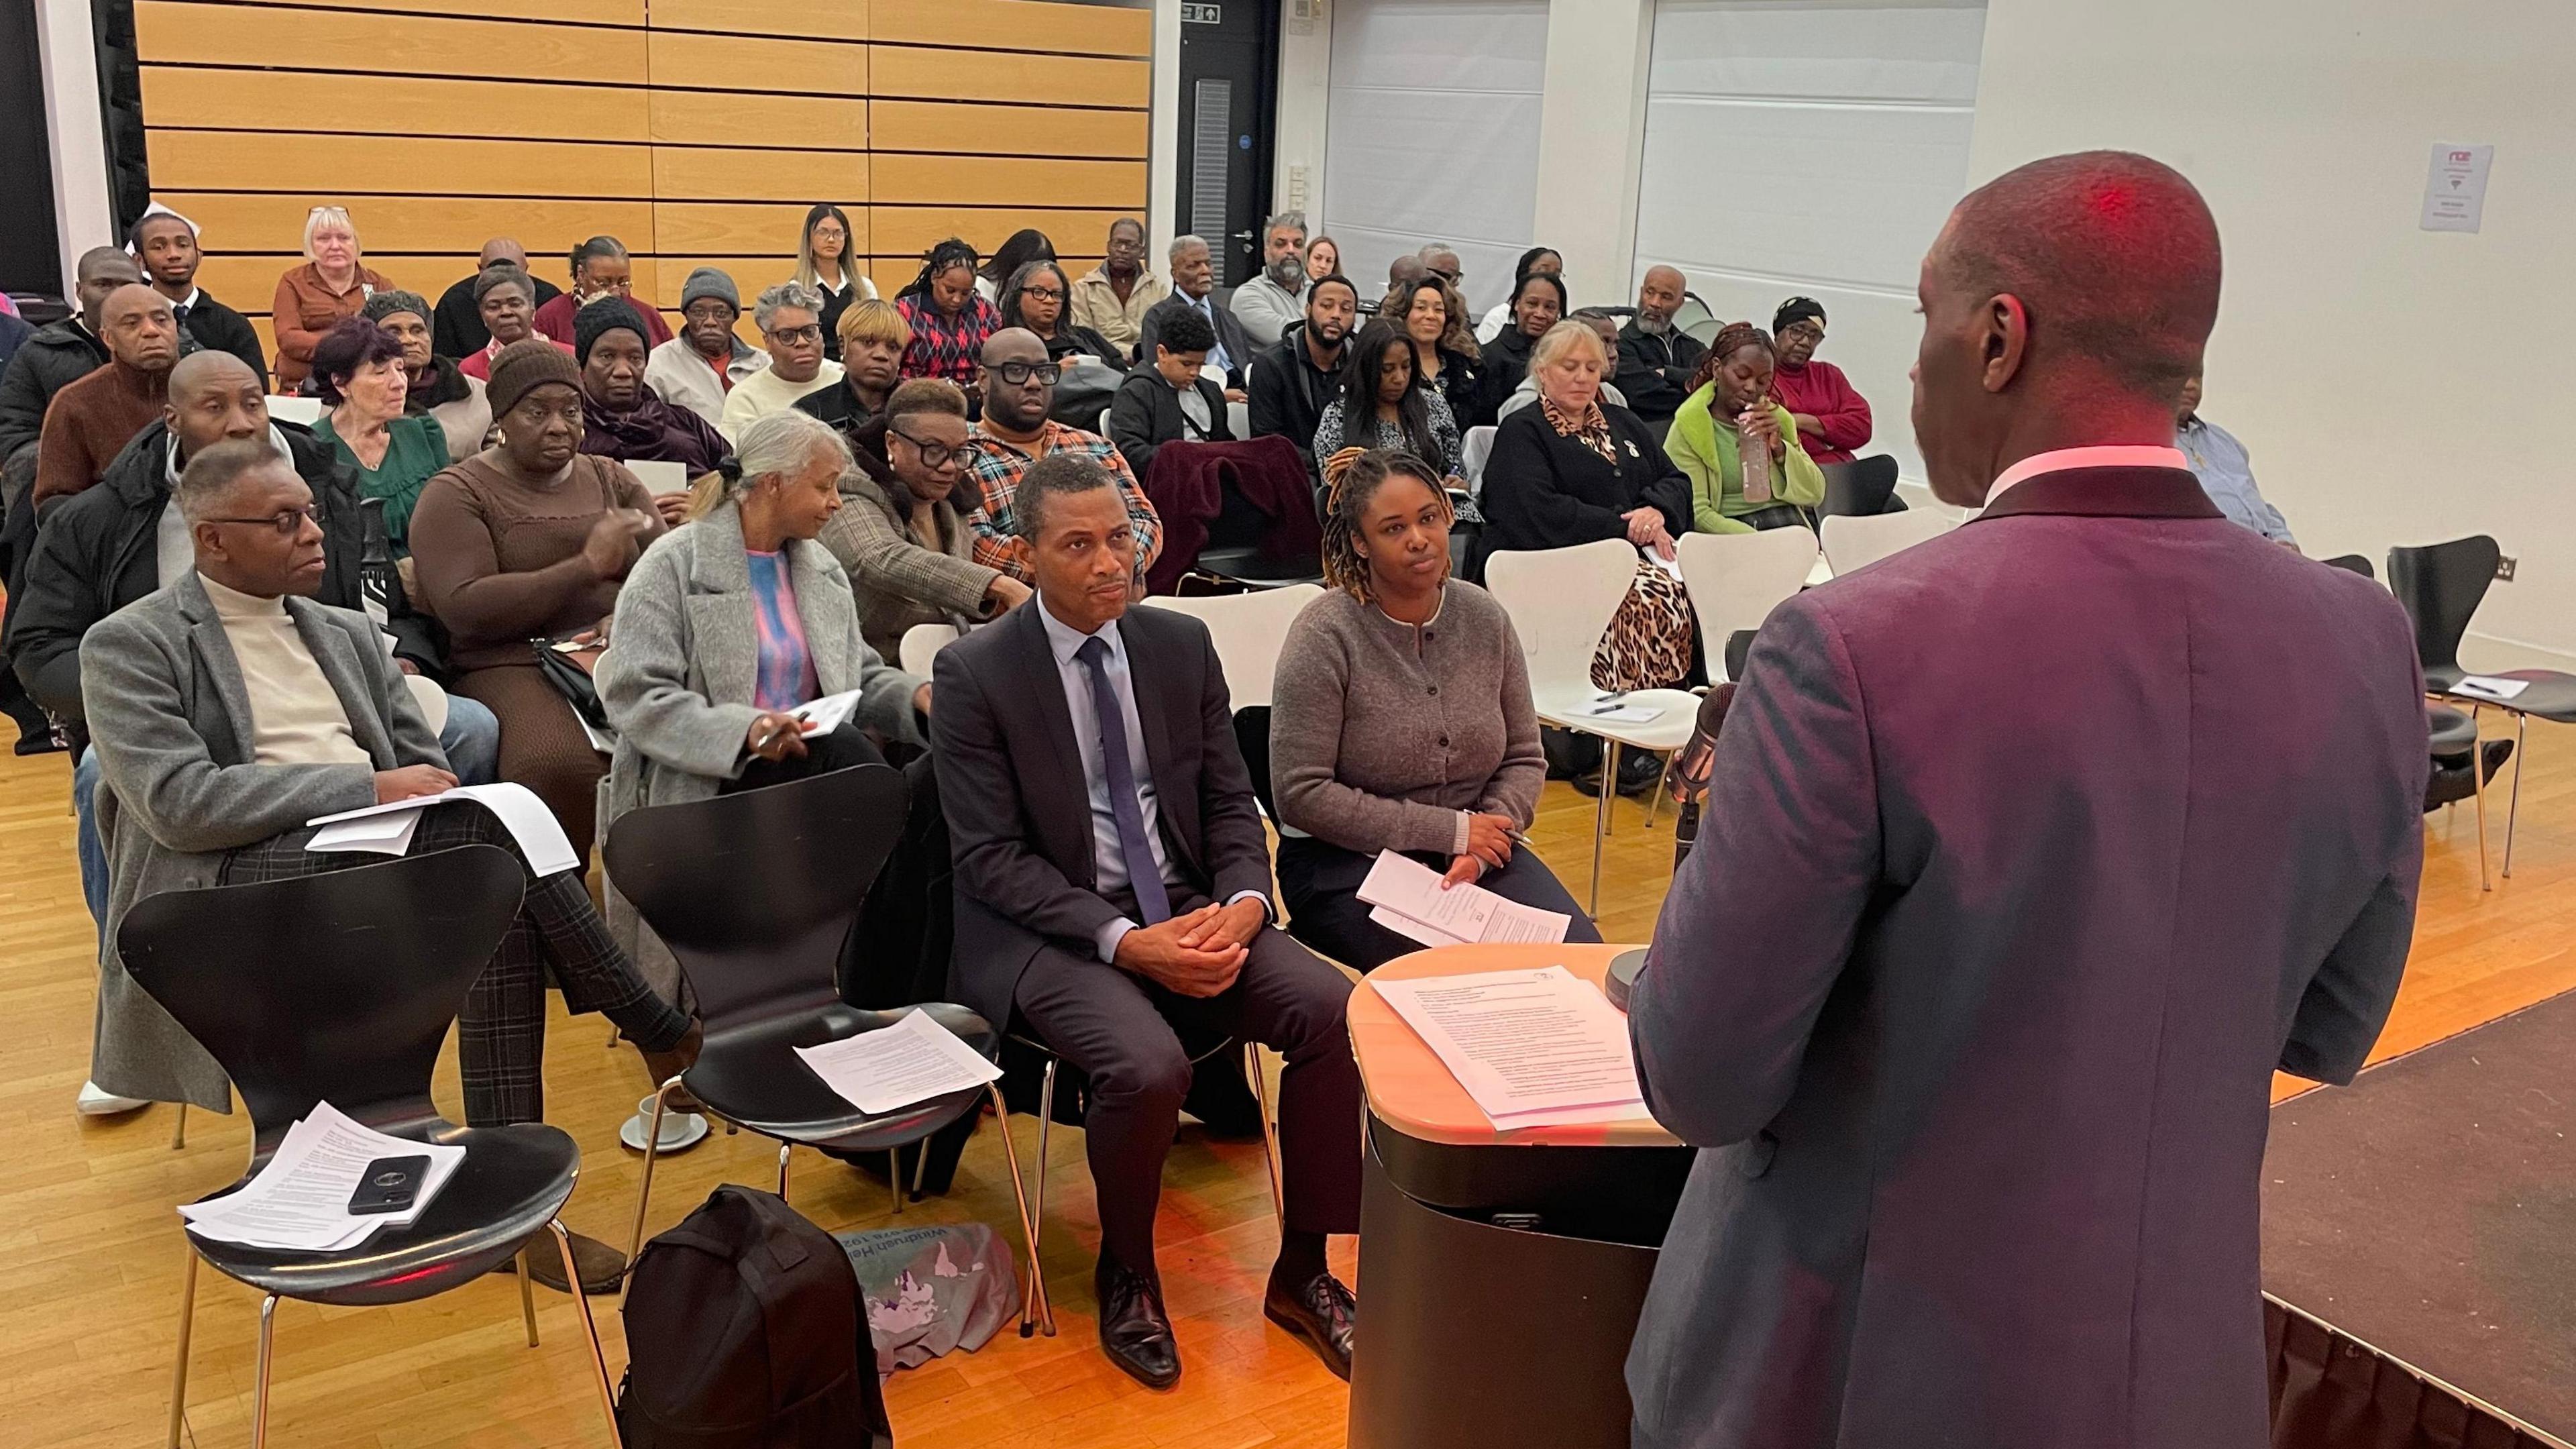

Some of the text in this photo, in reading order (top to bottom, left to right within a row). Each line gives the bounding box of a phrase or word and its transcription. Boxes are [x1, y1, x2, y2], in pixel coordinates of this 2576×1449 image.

[844, 1236, 870, 1248] 192
[848, 1228, 948, 1262] Windrush Hel
